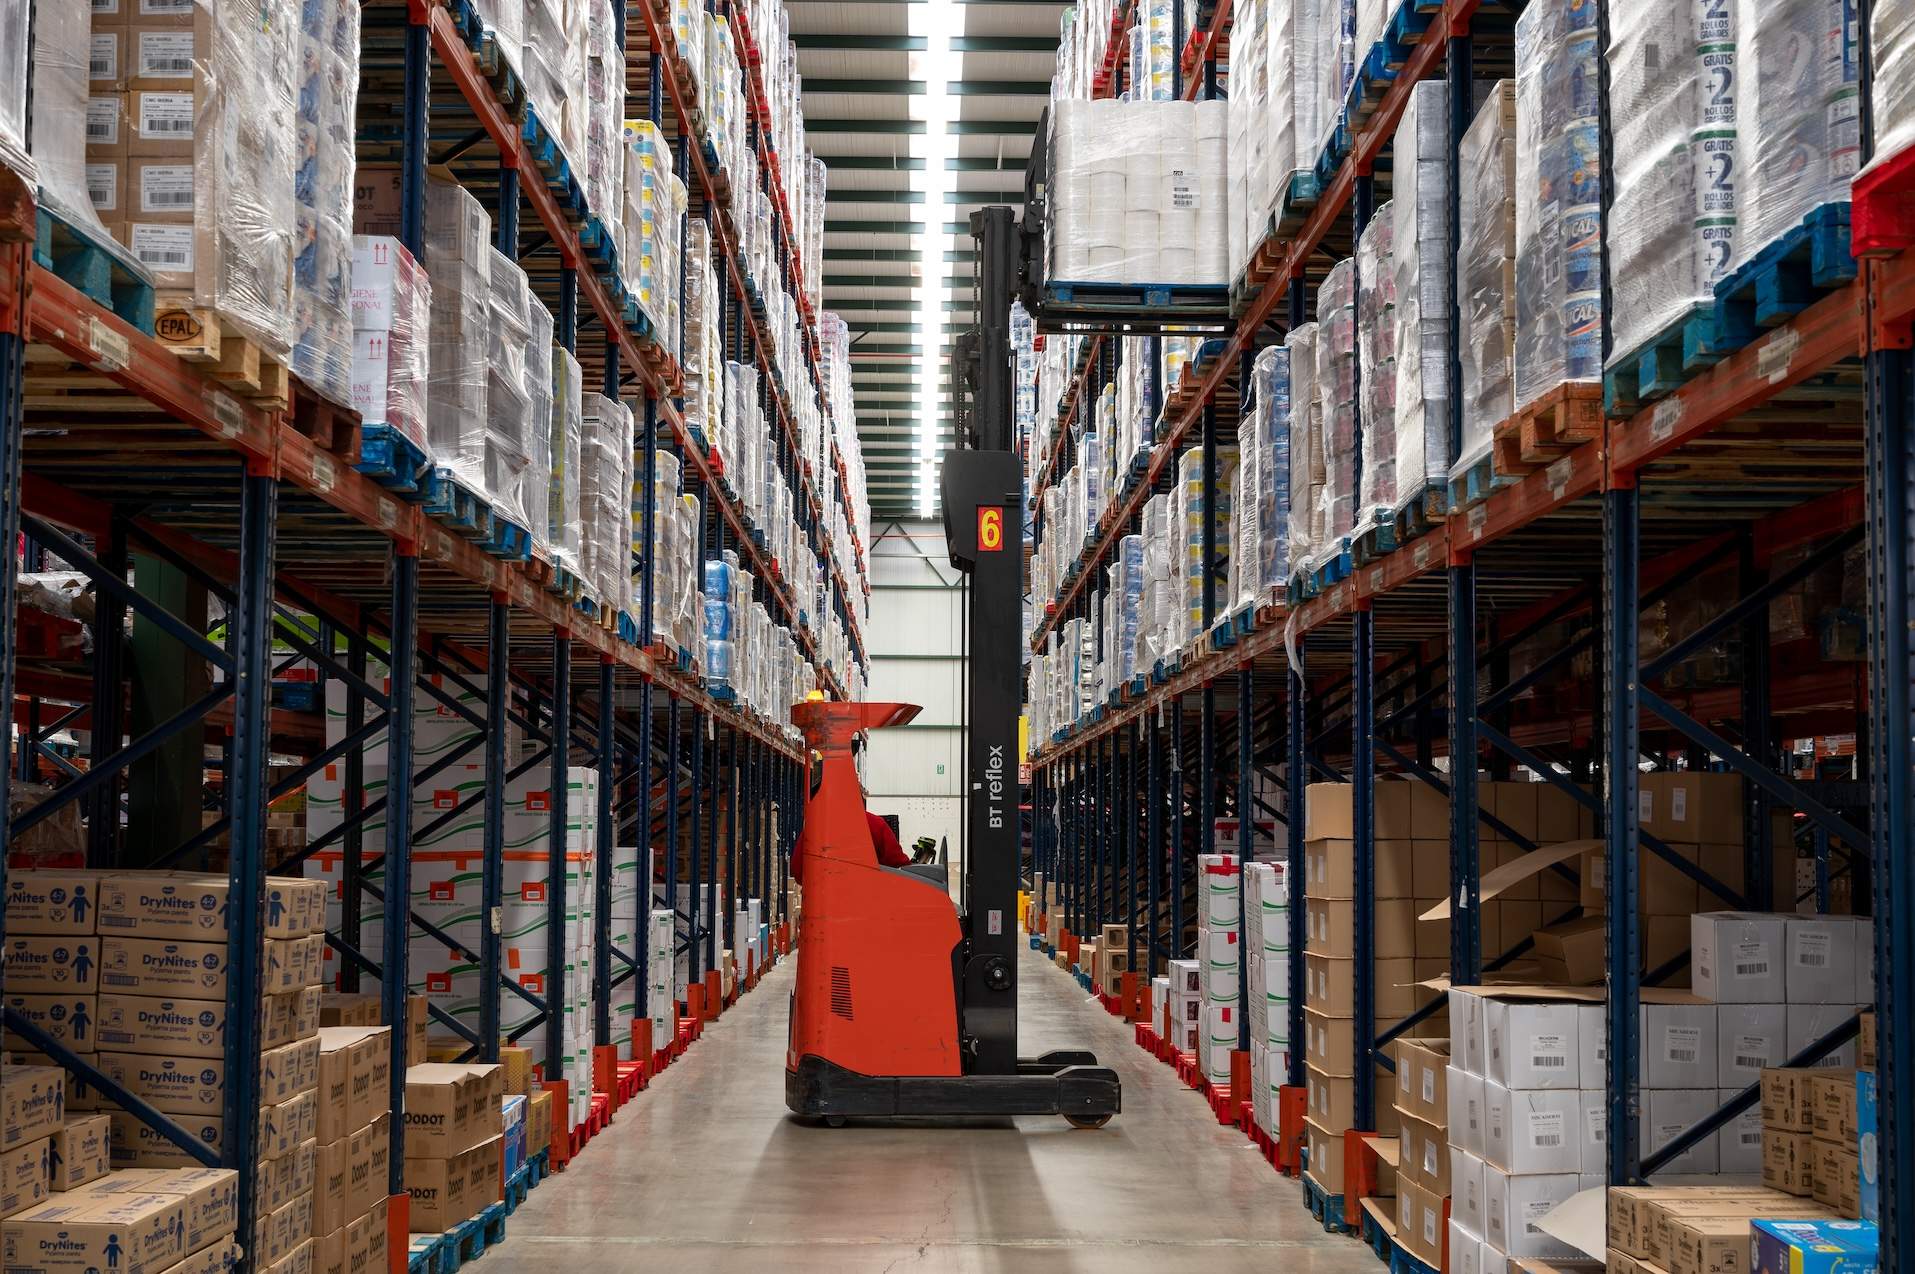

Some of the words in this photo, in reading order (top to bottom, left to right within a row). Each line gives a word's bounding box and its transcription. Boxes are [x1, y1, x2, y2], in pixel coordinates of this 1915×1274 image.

[1700, 20, 1728, 30] ROLLOS
[1704, 54, 1733, 66] GRATIS
[1705, 67, 1733, 105] +2
[1704, 106, 1734, 116] ROLLOS
[1704, 140, 1734, 152] GRATIS
[1705, 153, 1733, 191] +2
[356, 186, 375, 200] OT
[1704, 192, 1734, 201] ROLLOS
[1703, 227, 1732, 239] GRATIS
[352, 301, 383, 311] SONAL
[161, 319, 195, 336] EPAL
[353, 384, 372, 392] ENE
[982, 510, 999, 547] 6
[985, 745, 1002, 800] reflex
[989, 807, 1002, 828] BT
[7, 891, 45, 904] yNites
[140, 896, 195, 909] DryNites
[142, 955, 198, 968] DryNites
[138, 1011, 194, 1025] DryNites
[140, 1070, 195, 1084] DryNites
[407, 1187, 438, 1199] ODOT
[40, 1240, 86, 1252] DryNites
[1710, 1264, 1720, 1273] 3x
